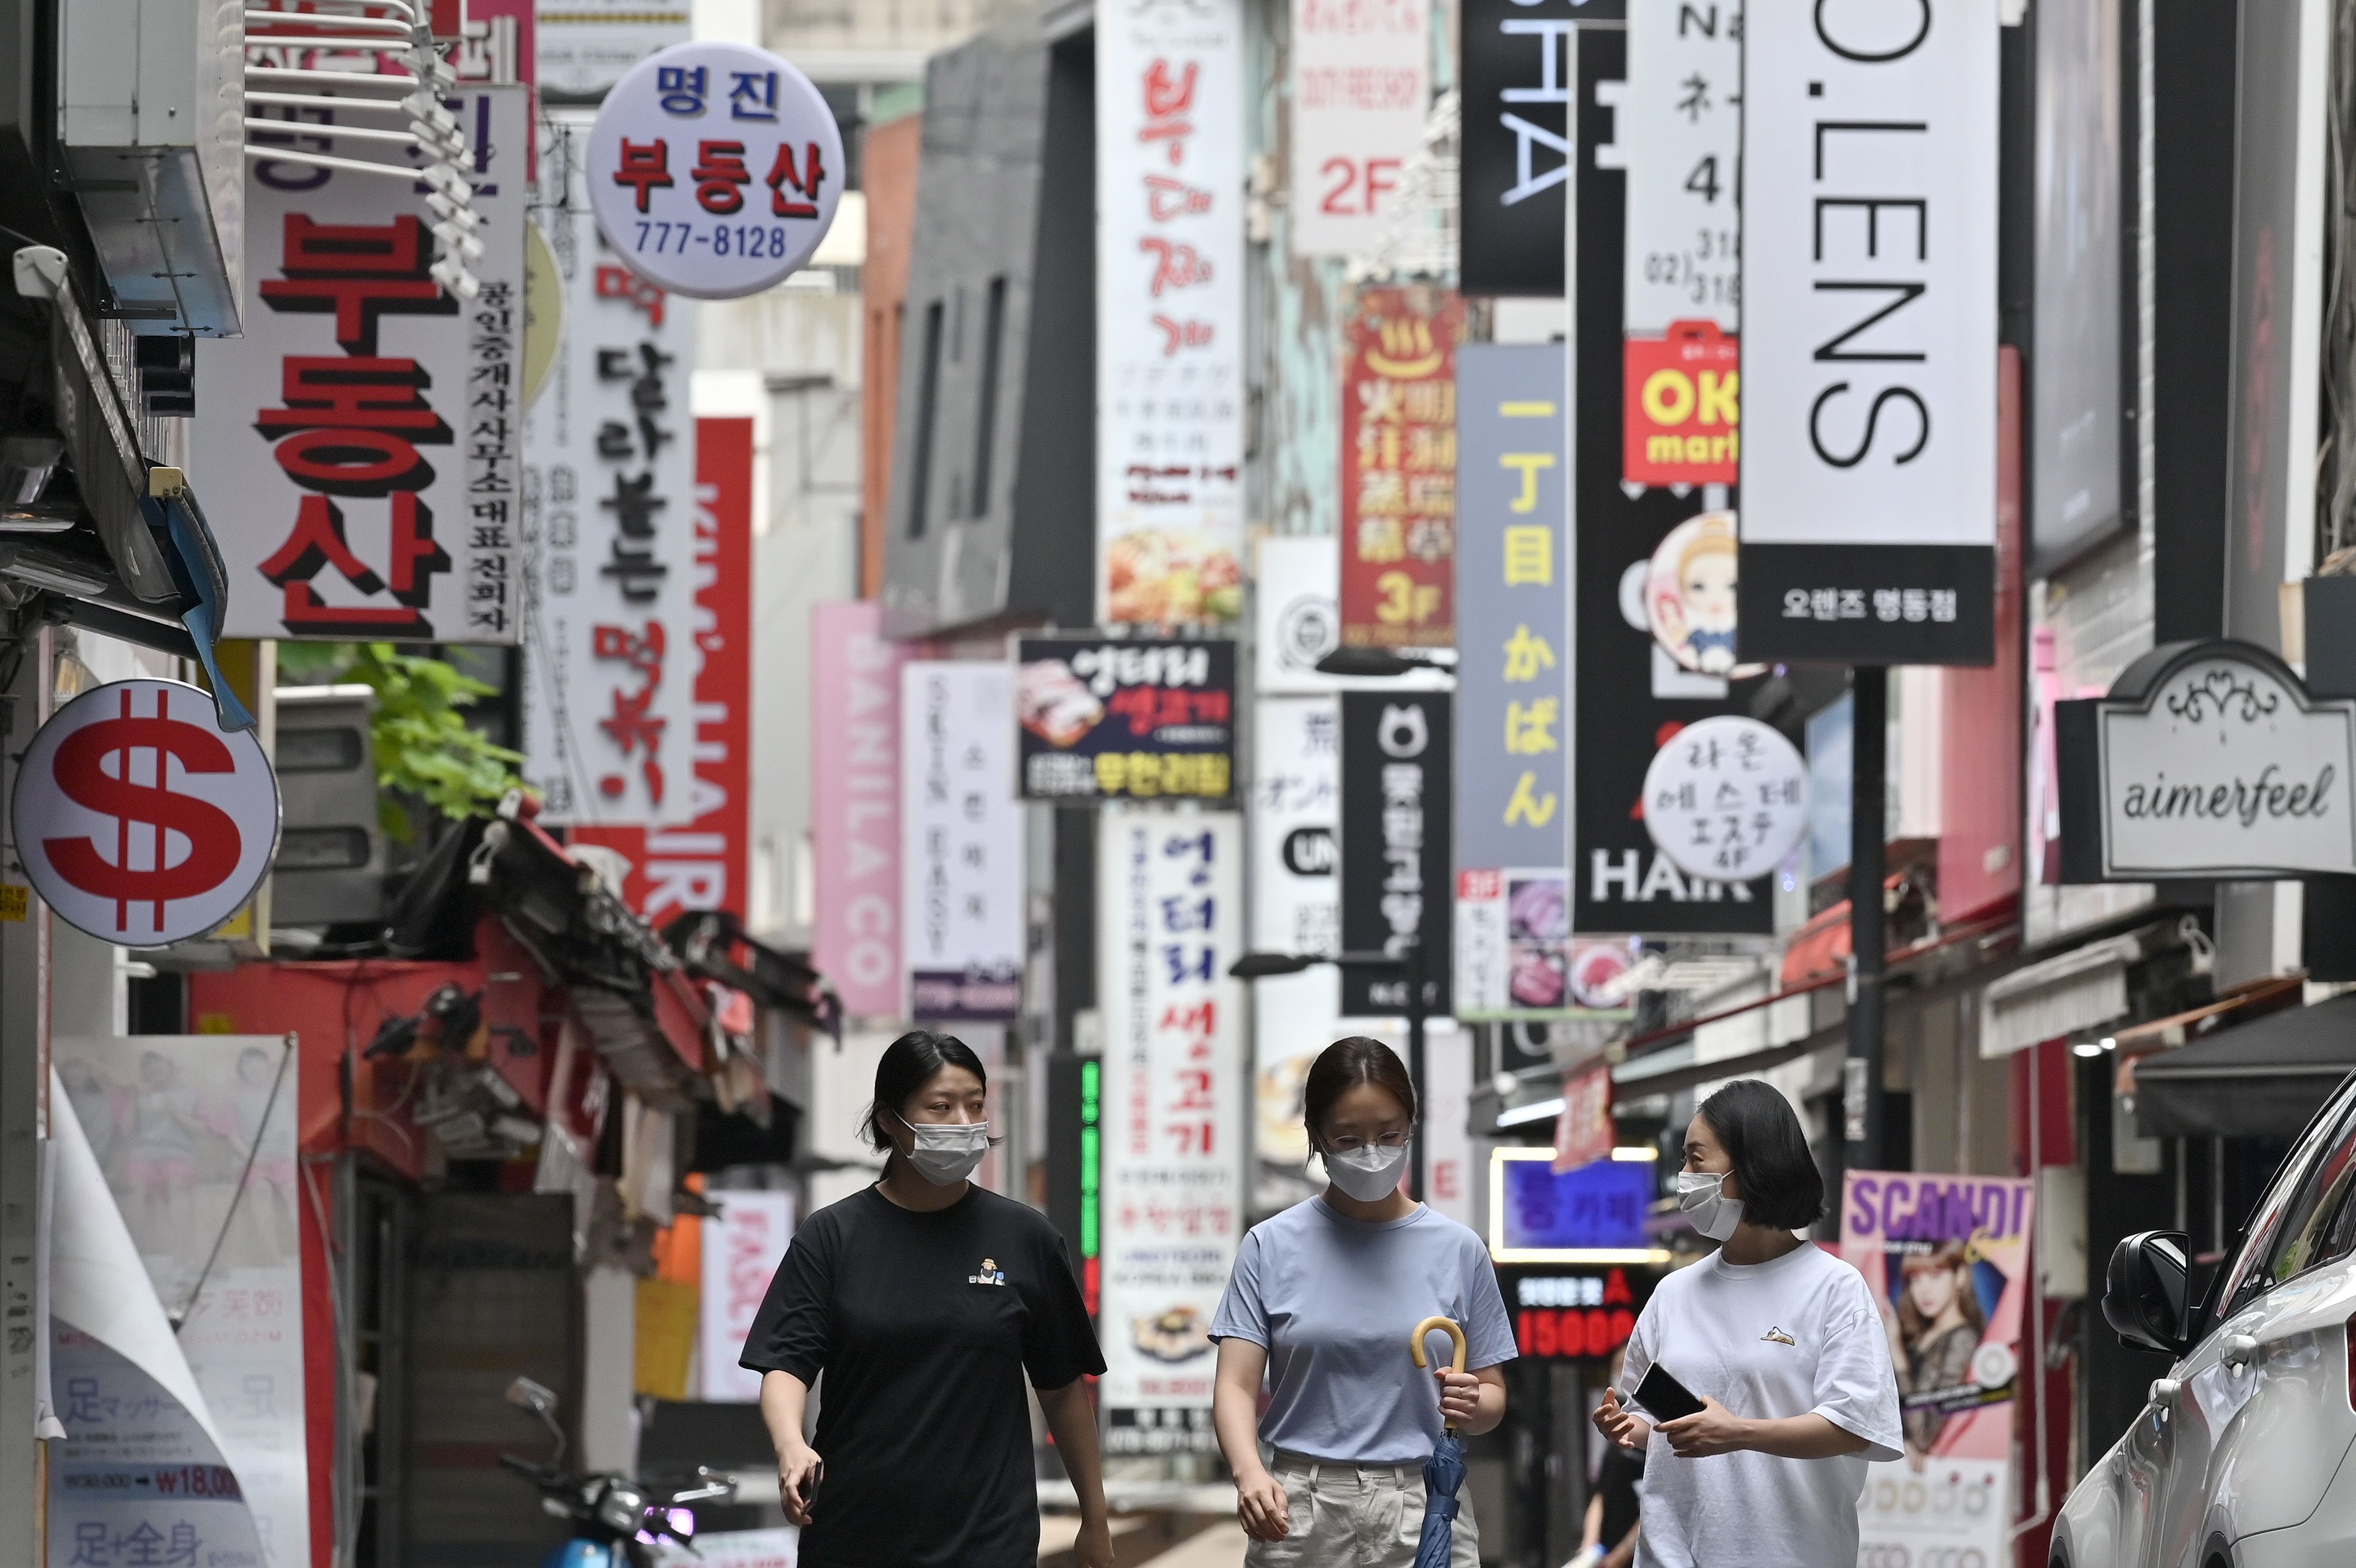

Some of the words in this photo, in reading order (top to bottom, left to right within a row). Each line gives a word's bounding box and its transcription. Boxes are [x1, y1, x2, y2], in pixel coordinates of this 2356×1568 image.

[657, 65, 779, 121] 명진
[1500, 0, 1577, 205] HA
[613, 138, 825, 220] 부동산
[1320, 157, 1402, 215] 2F
[634, 221, 787, 258] 777-8128
[1809, 0, 1931, 468] O.LENS
[251, 212, 460, 637] 부동산
[1641, 367, 1740, 427] OK
[1499, 400, 1558, 828] 一丁目かばん
[1781, 588, 1868, 621] 오렌즈
[2124, 764, 2334, 828] aimerfeel
[1851, 1178, 2026, 1242] SCANDI
